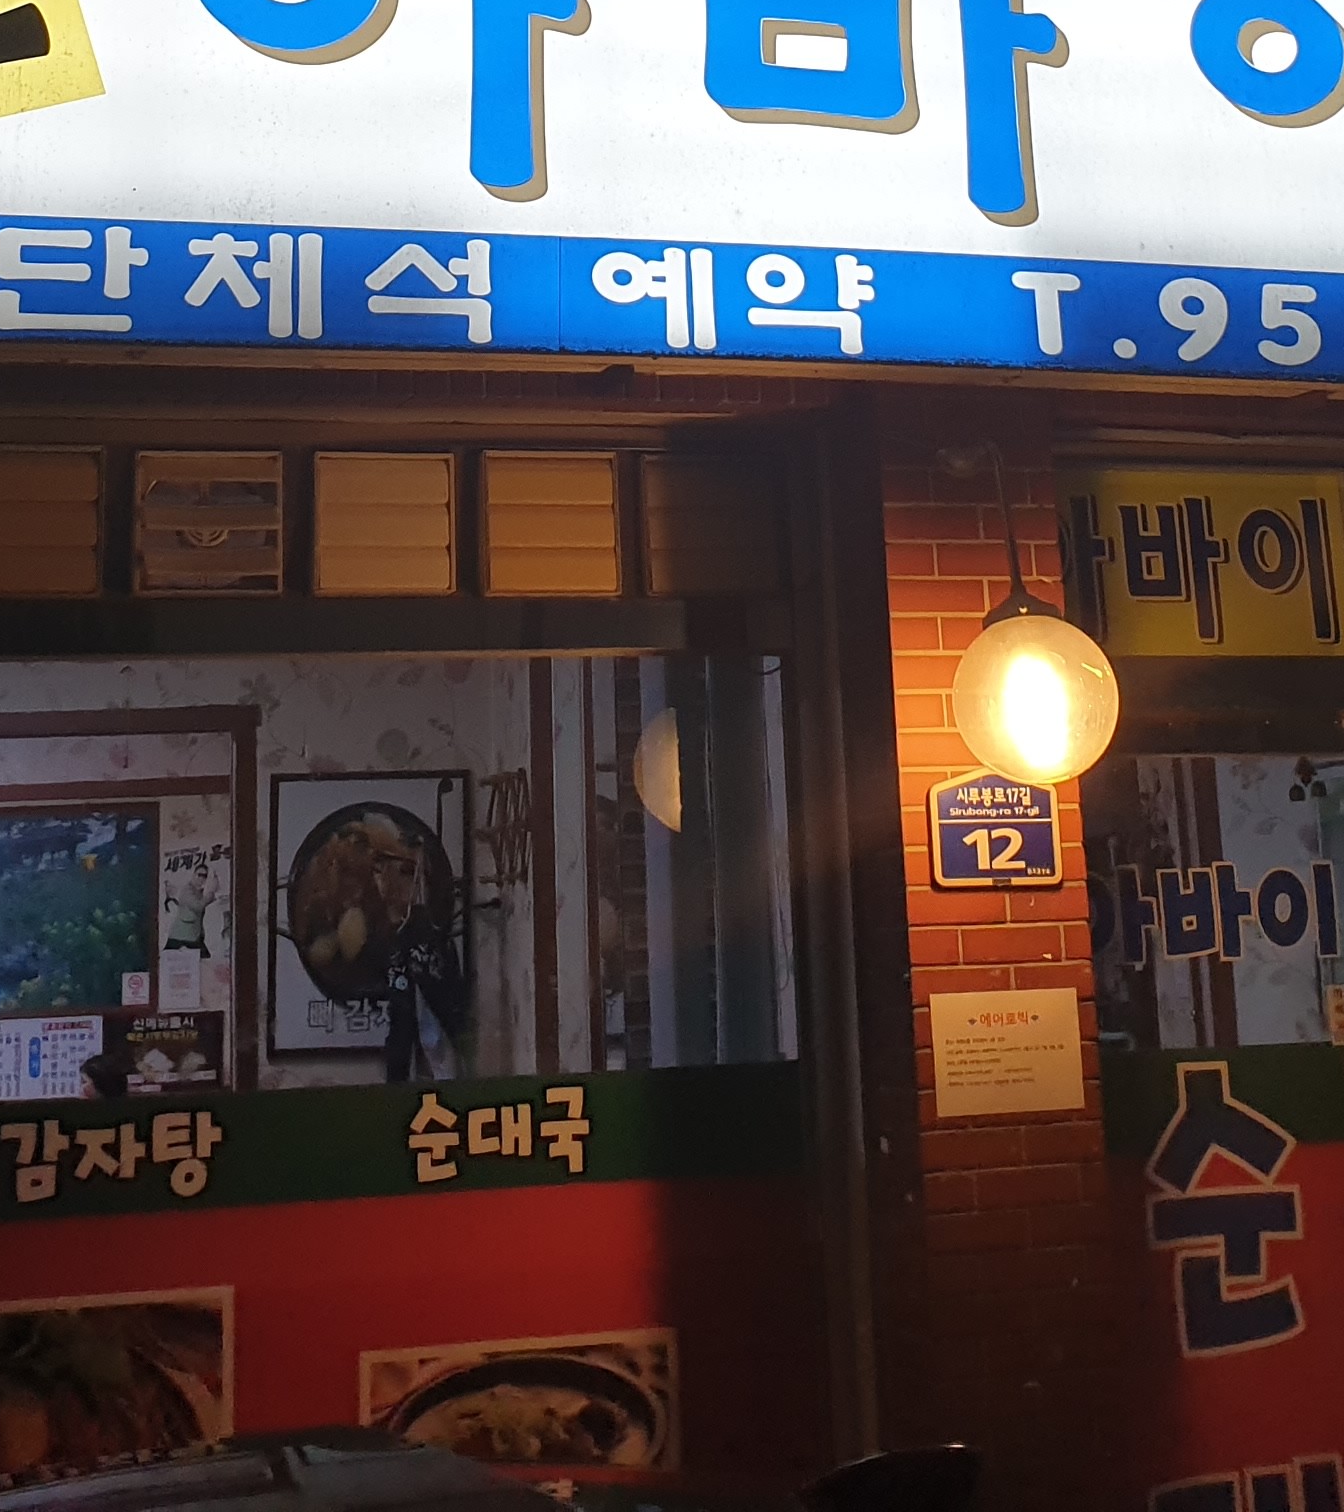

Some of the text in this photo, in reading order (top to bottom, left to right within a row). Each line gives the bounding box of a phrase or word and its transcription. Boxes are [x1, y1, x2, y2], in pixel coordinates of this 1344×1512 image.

[591, 246, 877, 355] 예약
[956, 786, 1032, 807] 시루봉로17길
[962, 827, 1027, 871] 12
[406, 1085, 593, 1185] 순대국
